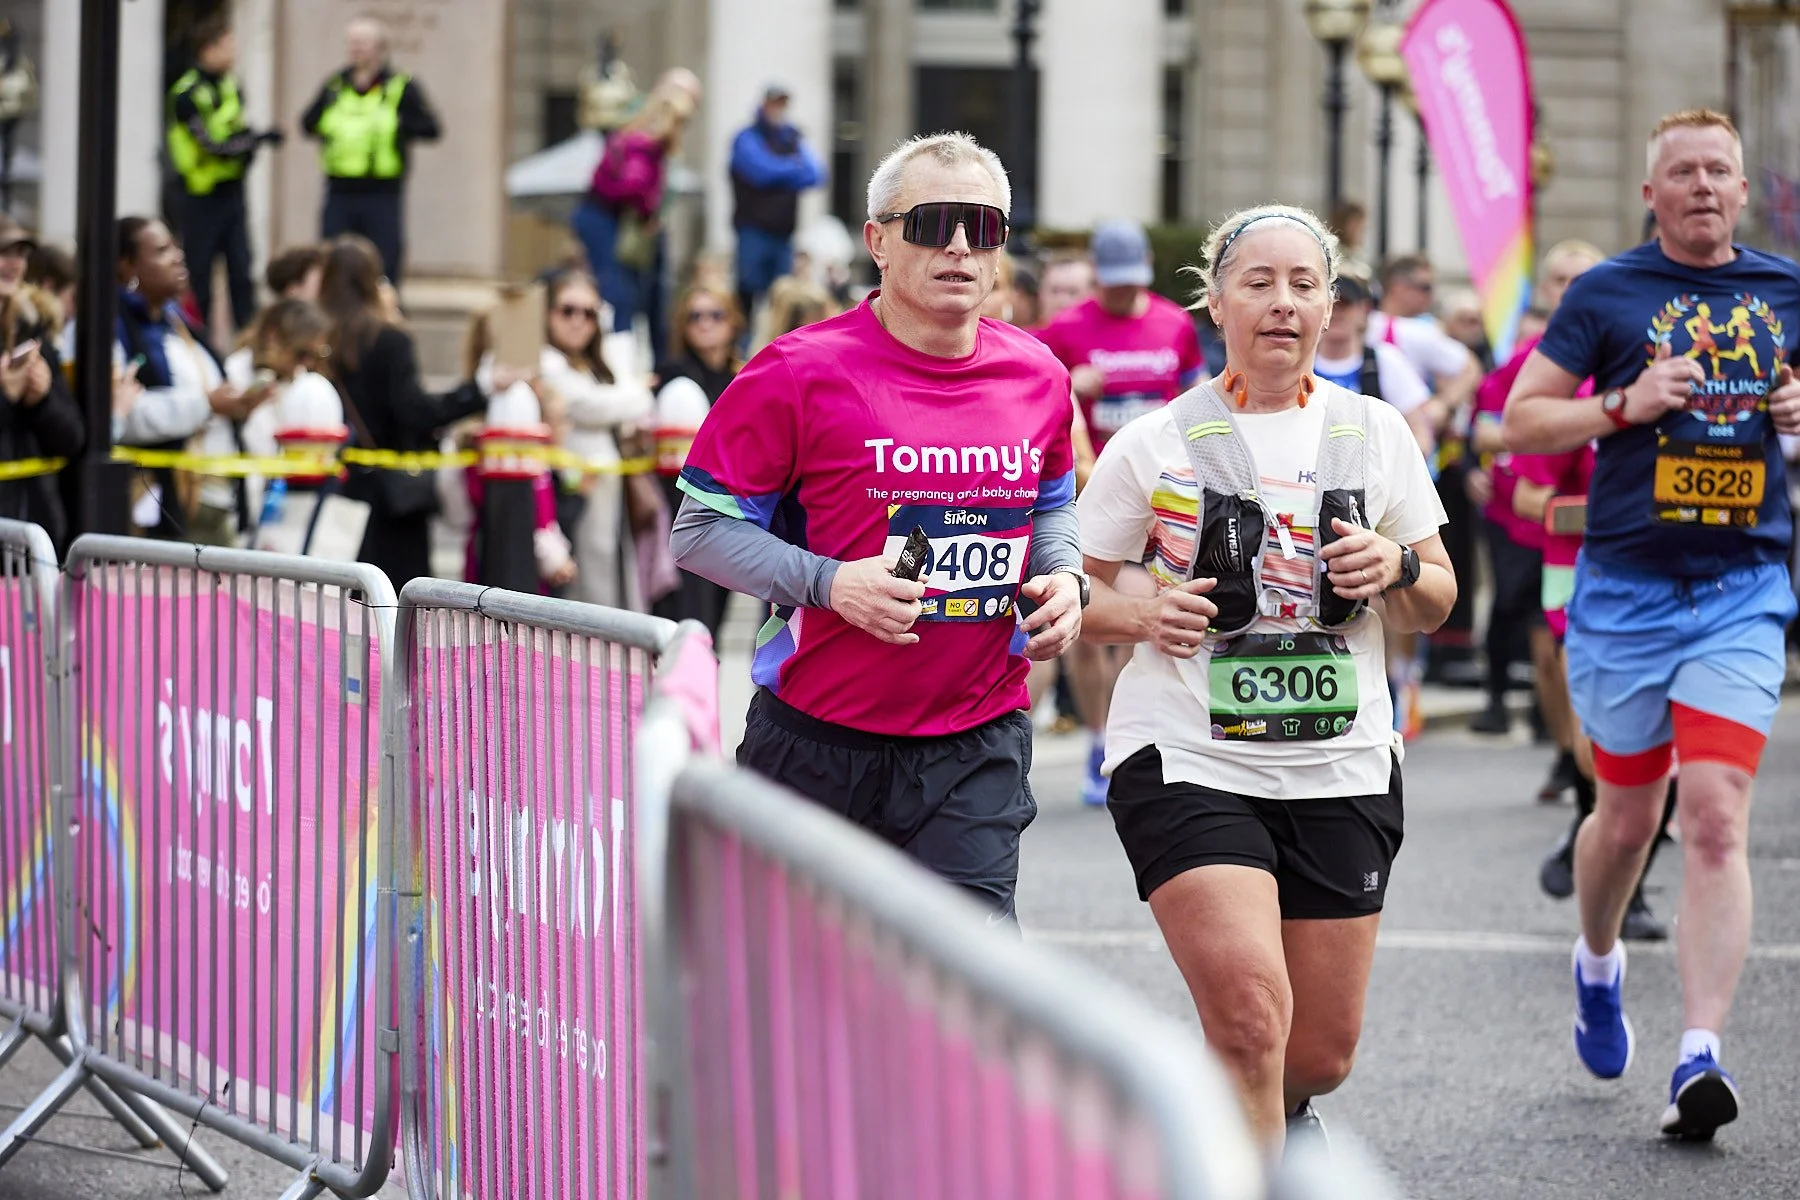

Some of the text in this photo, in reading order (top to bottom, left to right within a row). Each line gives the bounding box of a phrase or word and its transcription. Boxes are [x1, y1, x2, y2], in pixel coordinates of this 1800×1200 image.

[865, 438, 1042, 481] Tommy's
[1673, 467, 1752, 497] 3628
[866, 488, 888, 499] The
[892, 489, 954, 502] pregnancy
[957, 487, 978, 499] and
[982, 486, 1011, 499] baby
[944, 513, 987, 525] SIMON
[1277, 640, 1295, 650] JO
[1232, 665, 1338, 703] 6306
